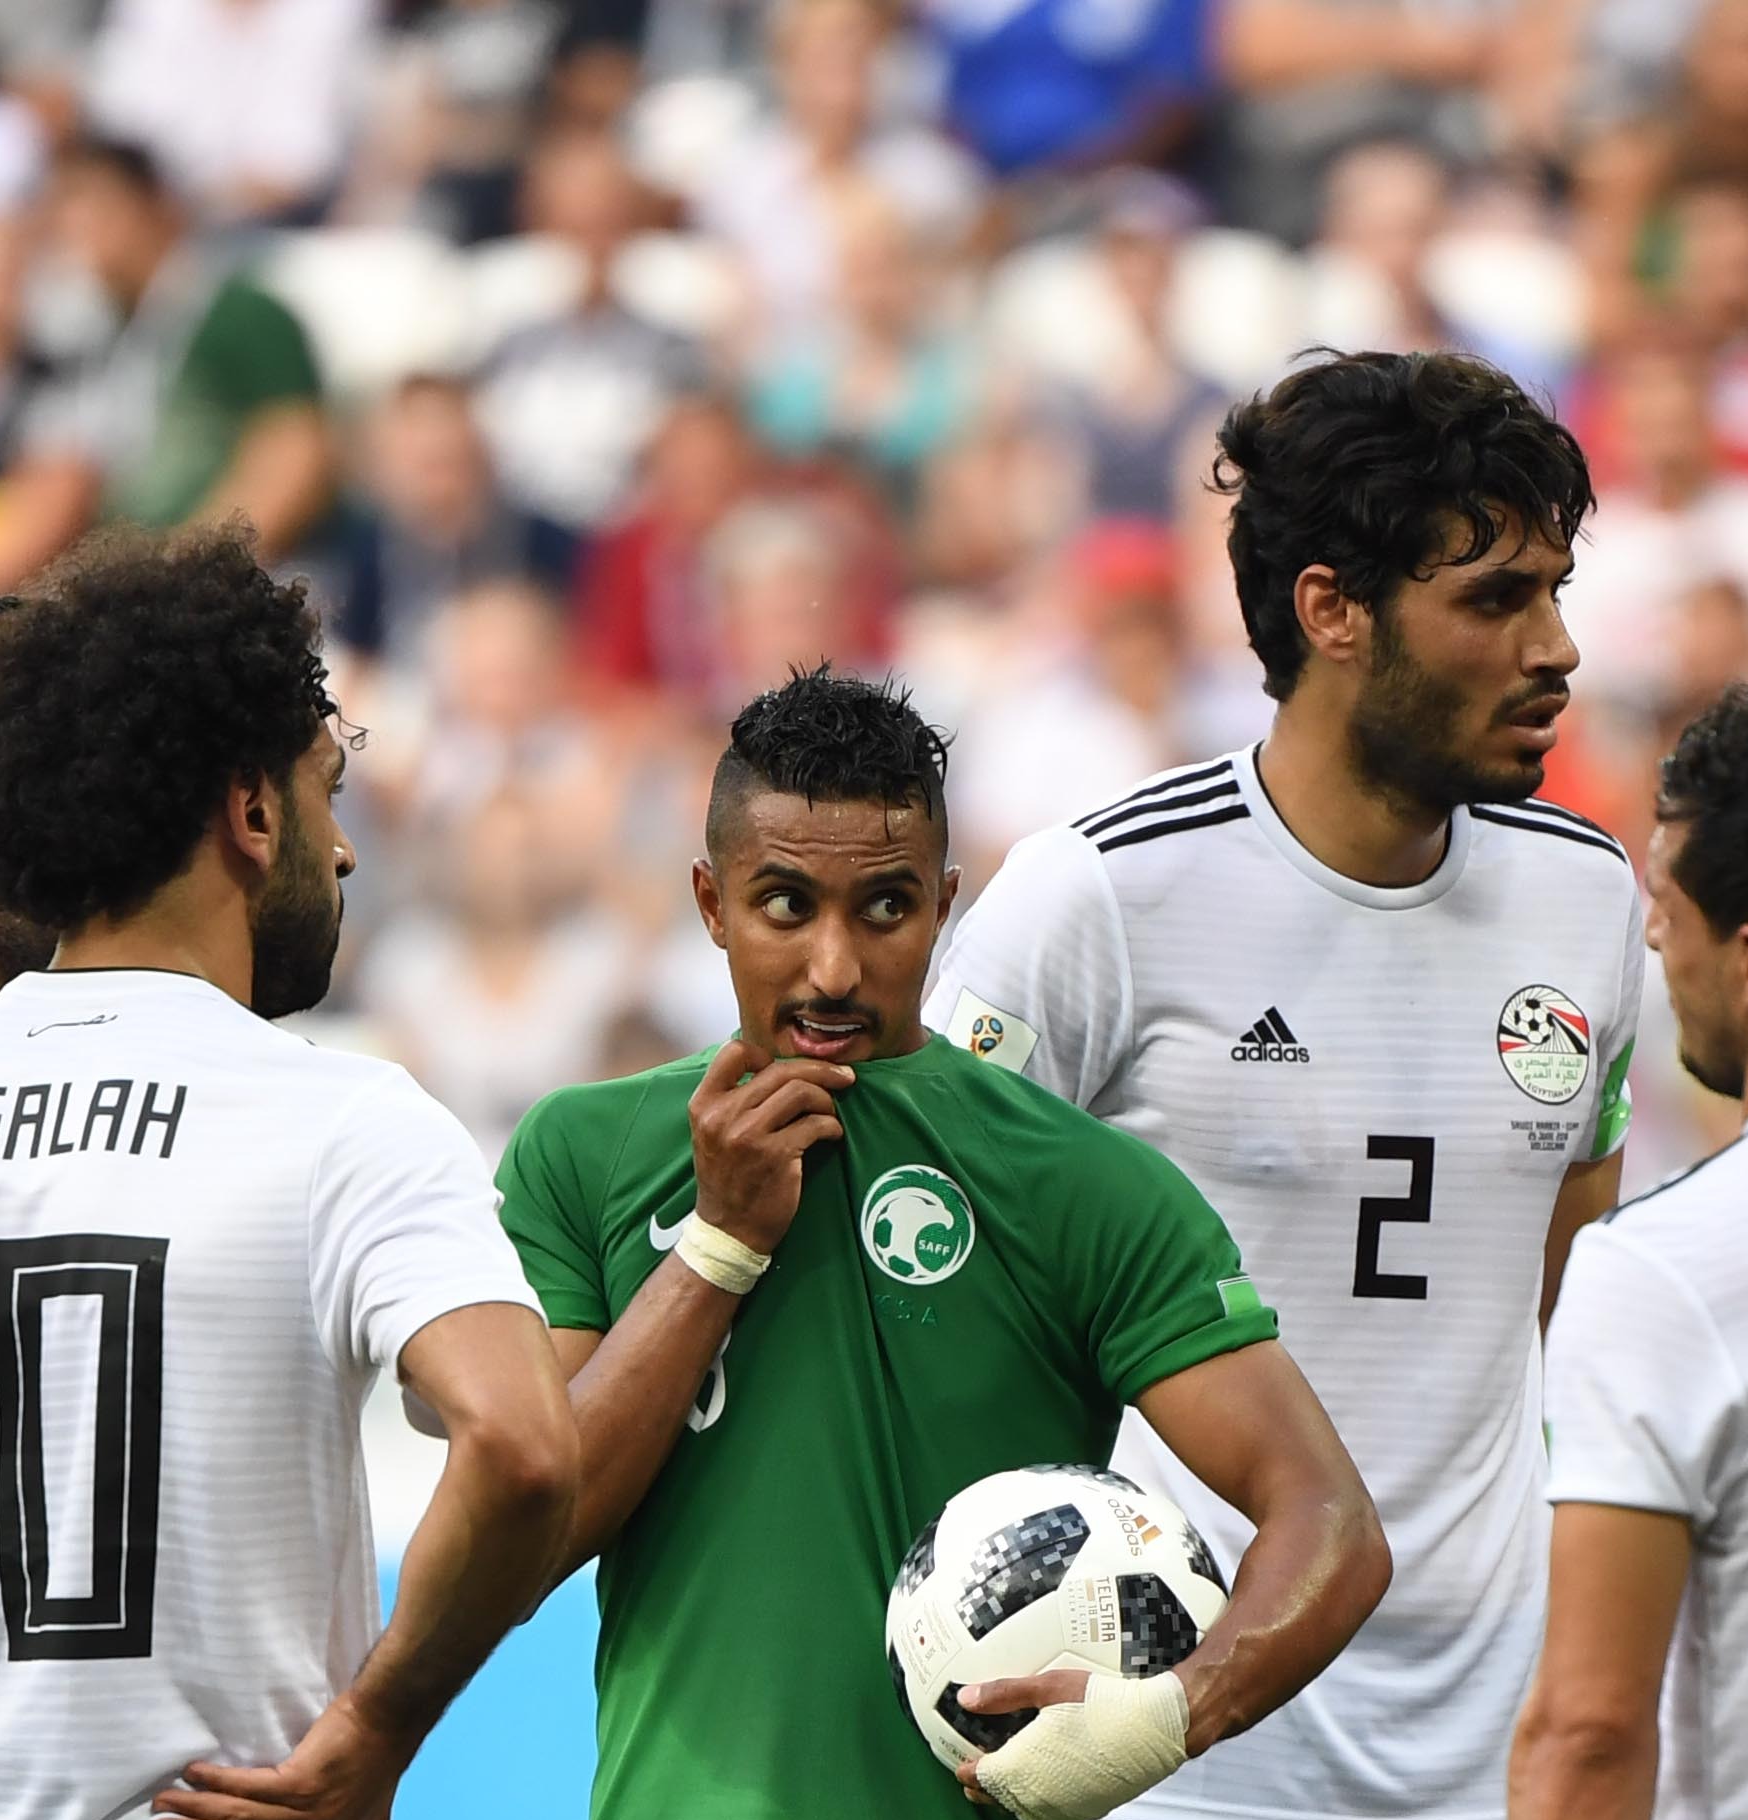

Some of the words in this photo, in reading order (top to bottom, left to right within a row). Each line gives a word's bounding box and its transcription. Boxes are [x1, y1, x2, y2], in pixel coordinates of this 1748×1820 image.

[1230, 1041, 1311, 1063] adidas
[1352, 1134, 1435, 1300] 2
[918, 1239, 951, 1256] SAFF
[1107, 1498, 1143, 1558] adidas
[1096, 1575, 1117, 1643] TELSTAR
